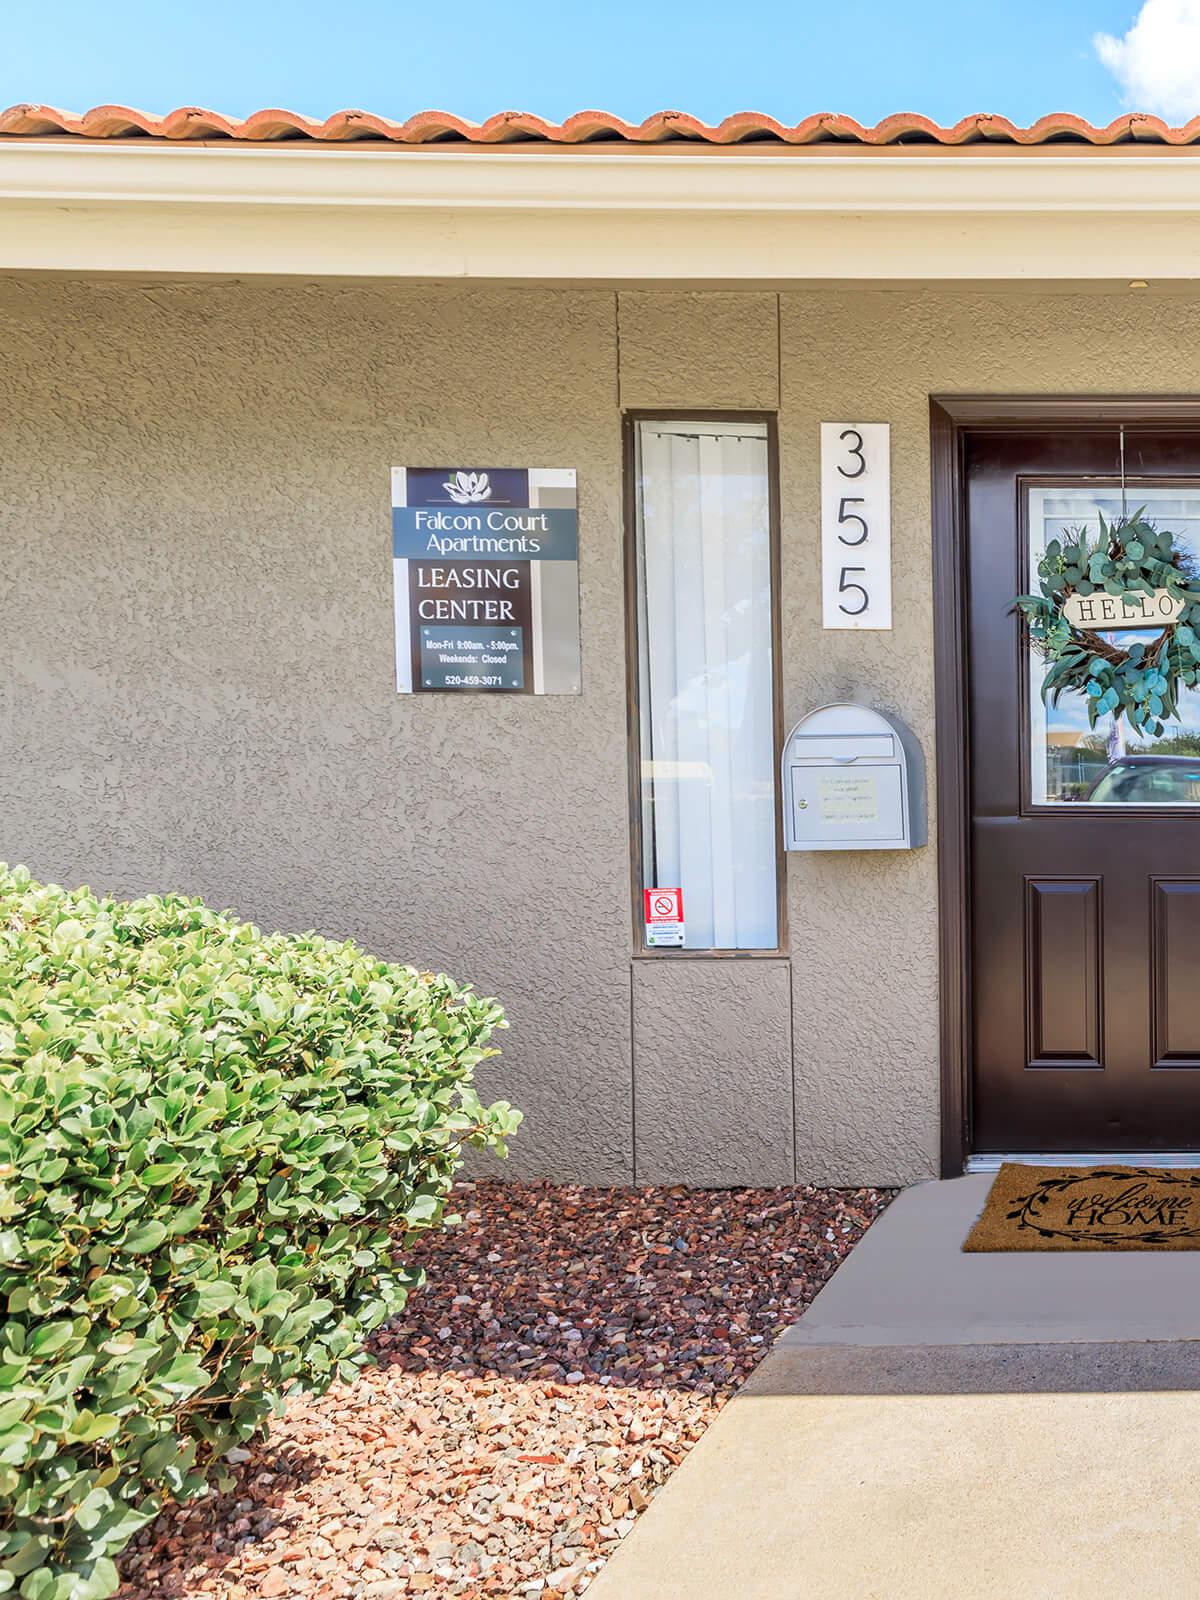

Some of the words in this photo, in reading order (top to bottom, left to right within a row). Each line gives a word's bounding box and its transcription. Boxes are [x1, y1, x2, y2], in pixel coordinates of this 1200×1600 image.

[415, 511, 481, 531] Falcon
[486, 511, 549, 531] Court
[426, 534, 541, 555] Apartments
[417, 568, 520, 588] LEASING
[418, 599, 515, 621] CENTER
[1077, 595, 1173, 621] HELLO
[426, 640, 454, 650] Mon-Fri
[439, 653, 479, 664] Weekends:
[481, 653, 507, 664] Closed
[444, 675, 502, 686] 520-459-3071
[1066, 1182, 1195, 1213] welcome
[1066, 1209, 1188, 1226] HOME
